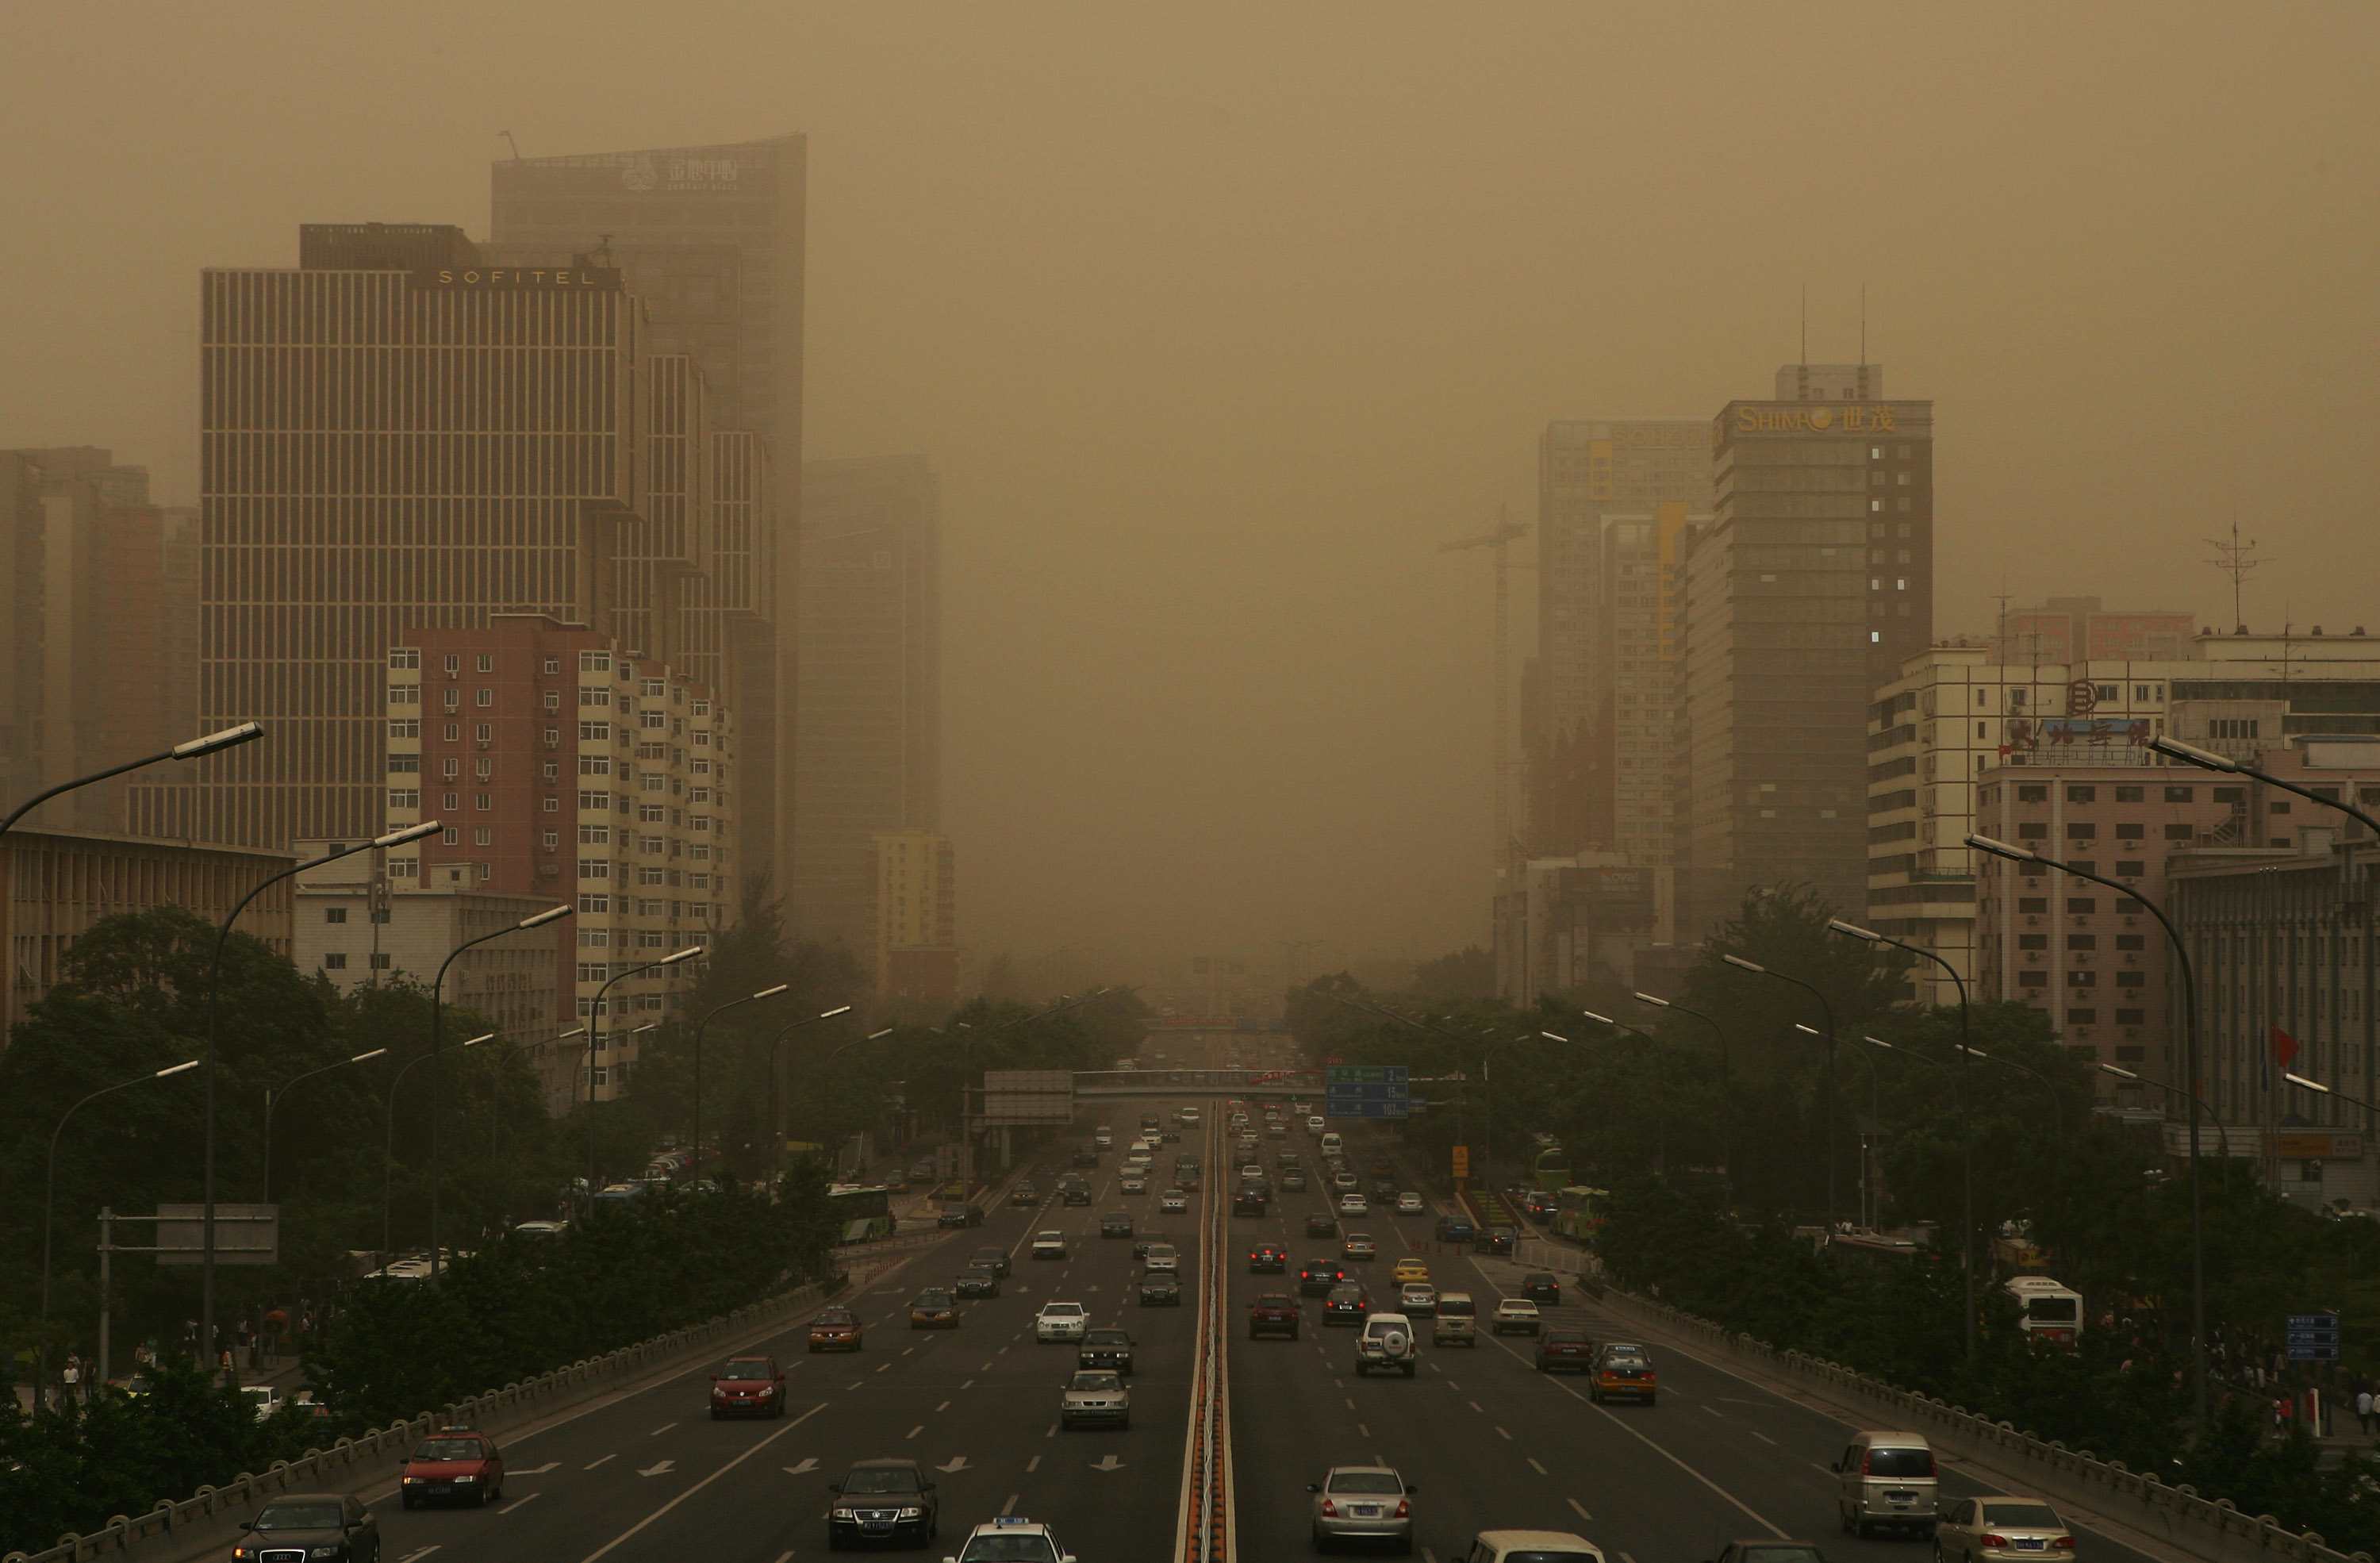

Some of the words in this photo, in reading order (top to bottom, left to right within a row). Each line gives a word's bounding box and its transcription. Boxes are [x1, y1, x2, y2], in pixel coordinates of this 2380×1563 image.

[438, 270, 595, 285] SOFITEL
[1841, 405, 1897, 432] 世茂
[1389, 1070, 1394, 1081] 2
[1387, 1085, 1396, 1098] 15
[1383, 1103, 1396, 1116] 103
